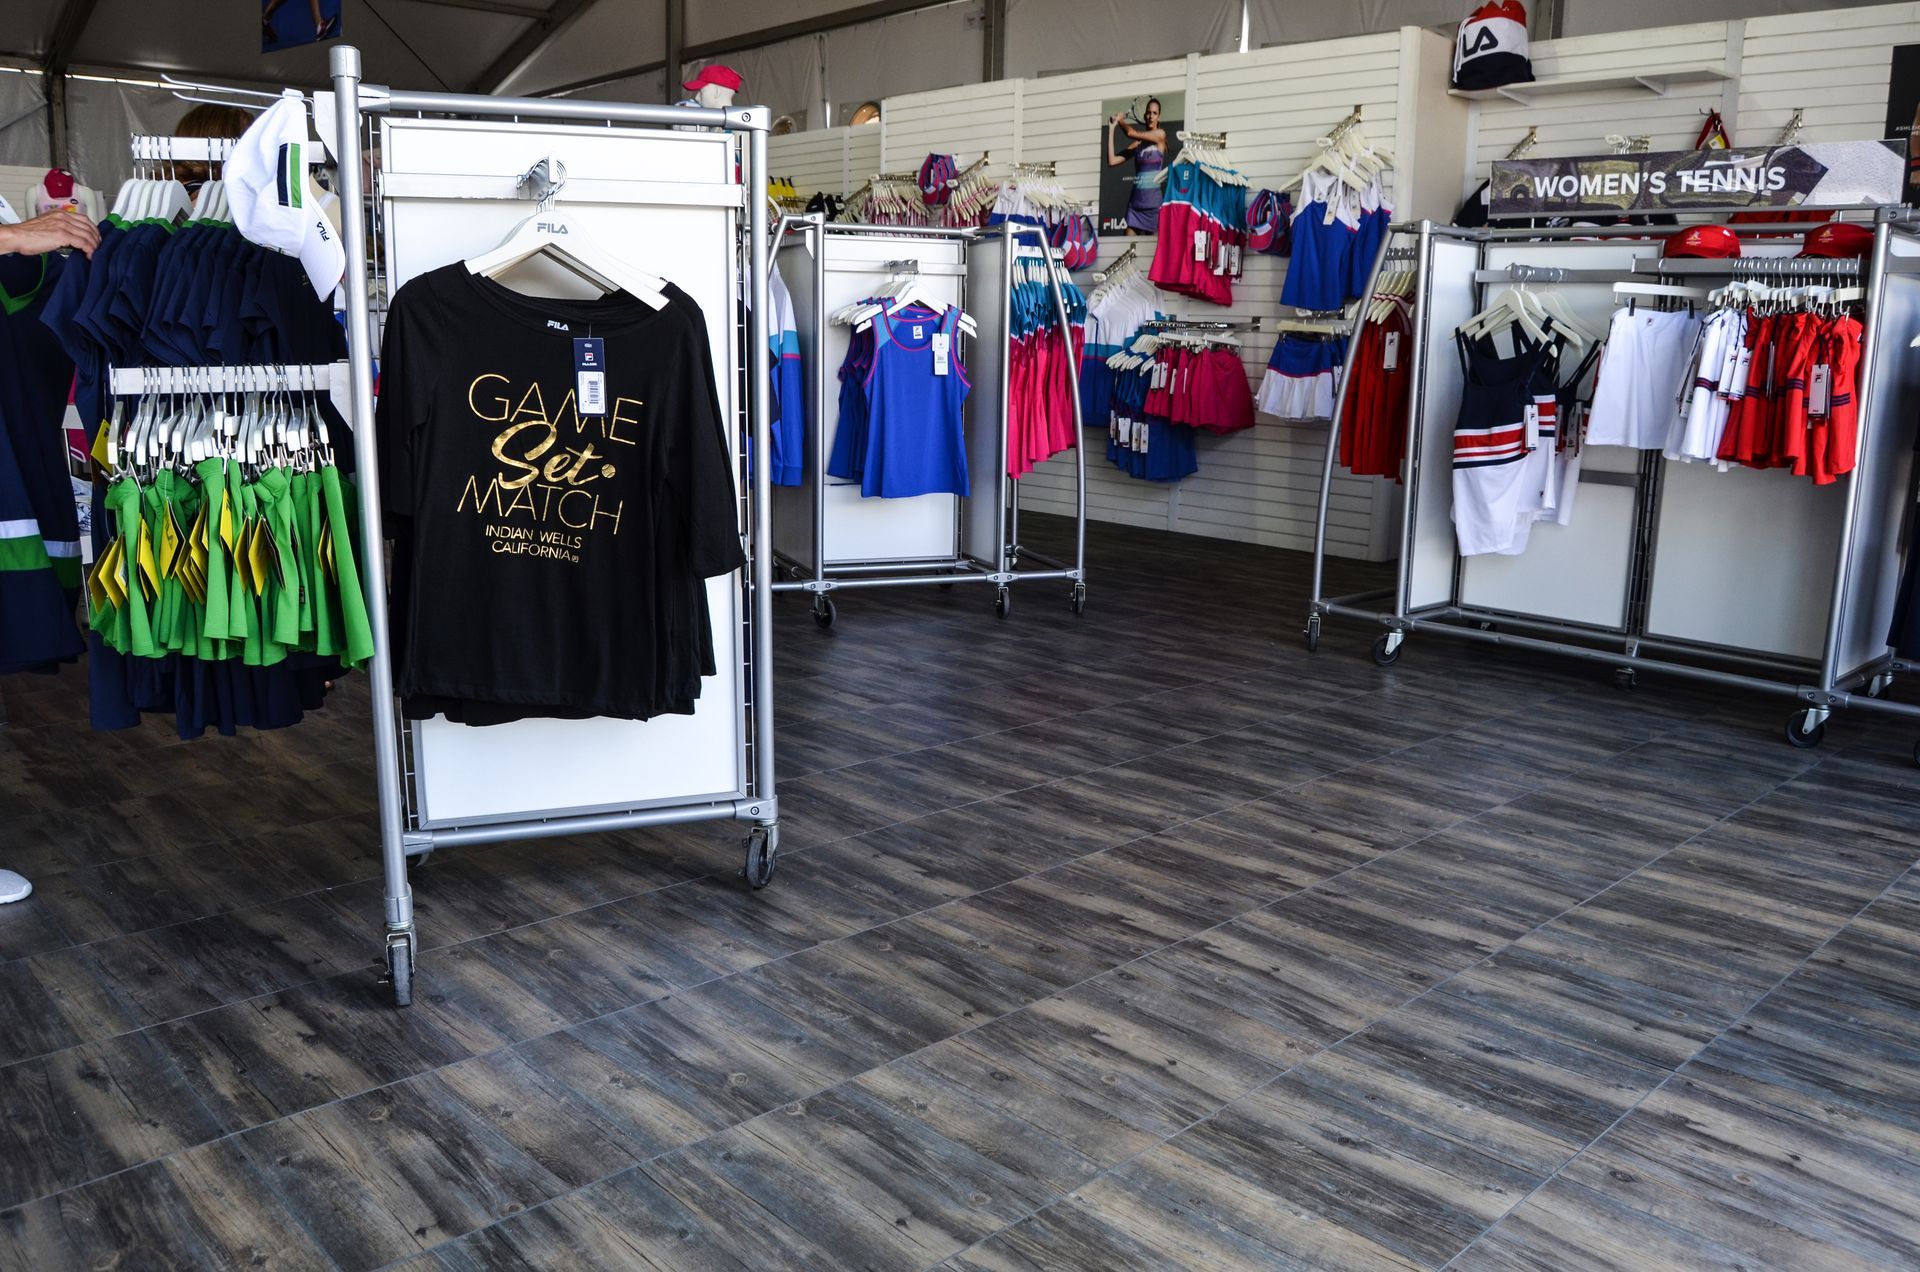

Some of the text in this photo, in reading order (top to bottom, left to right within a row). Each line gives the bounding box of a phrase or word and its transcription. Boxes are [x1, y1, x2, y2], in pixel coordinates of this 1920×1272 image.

[1463, 26, 1499, 58] LA
[1534, 166, 1786, 198] WOMEN'S TENNIS
[316, 221, 330, 242] FILA
[537, 222, 569, 235] FILA
[1103, 217, 1128, 230] FILA
[547, 319, 570, 331] FILA
[468, 373, 644, 446] GAME
[491, 420, 604, 490] Set
[456, 475, 624, 535] MATCH
[485, 524, 582, 549] INDIAN WELLS
[491, 541, 571, 561] CALIFORNIA
